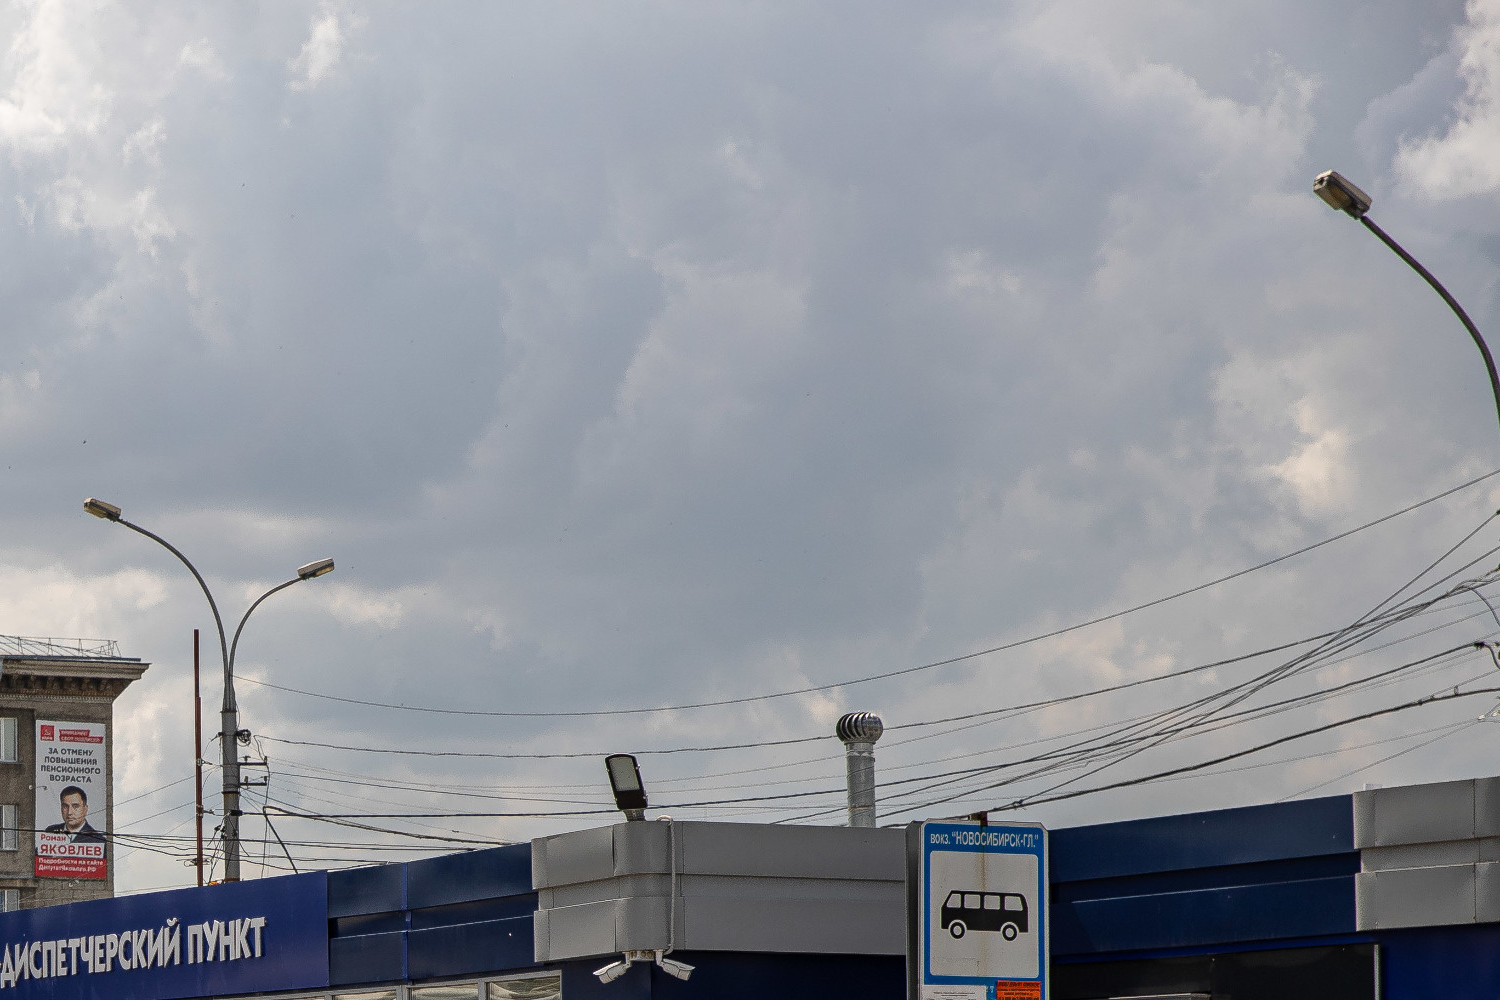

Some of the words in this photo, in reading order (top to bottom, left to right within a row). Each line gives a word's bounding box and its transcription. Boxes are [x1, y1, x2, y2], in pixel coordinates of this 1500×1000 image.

[60, 748, 94, 756] ОТМЕНУ
[44, 756, 98, 766] ПОВЫШЕНИЯ
[40, 765, 101, 775] ПЕНСИОННОГО
[49, 774, 92, 783] ВОЗРАСТА
[40, 834, 67, 842] Роман
[930, 833, 950, 845] ВОКЗ.
[40, 844, 102, 856] ЯКОВЛЕВ
[38, 858, 78, 866] Подробности
[187, 917, 266, 965] ПУНКТ
